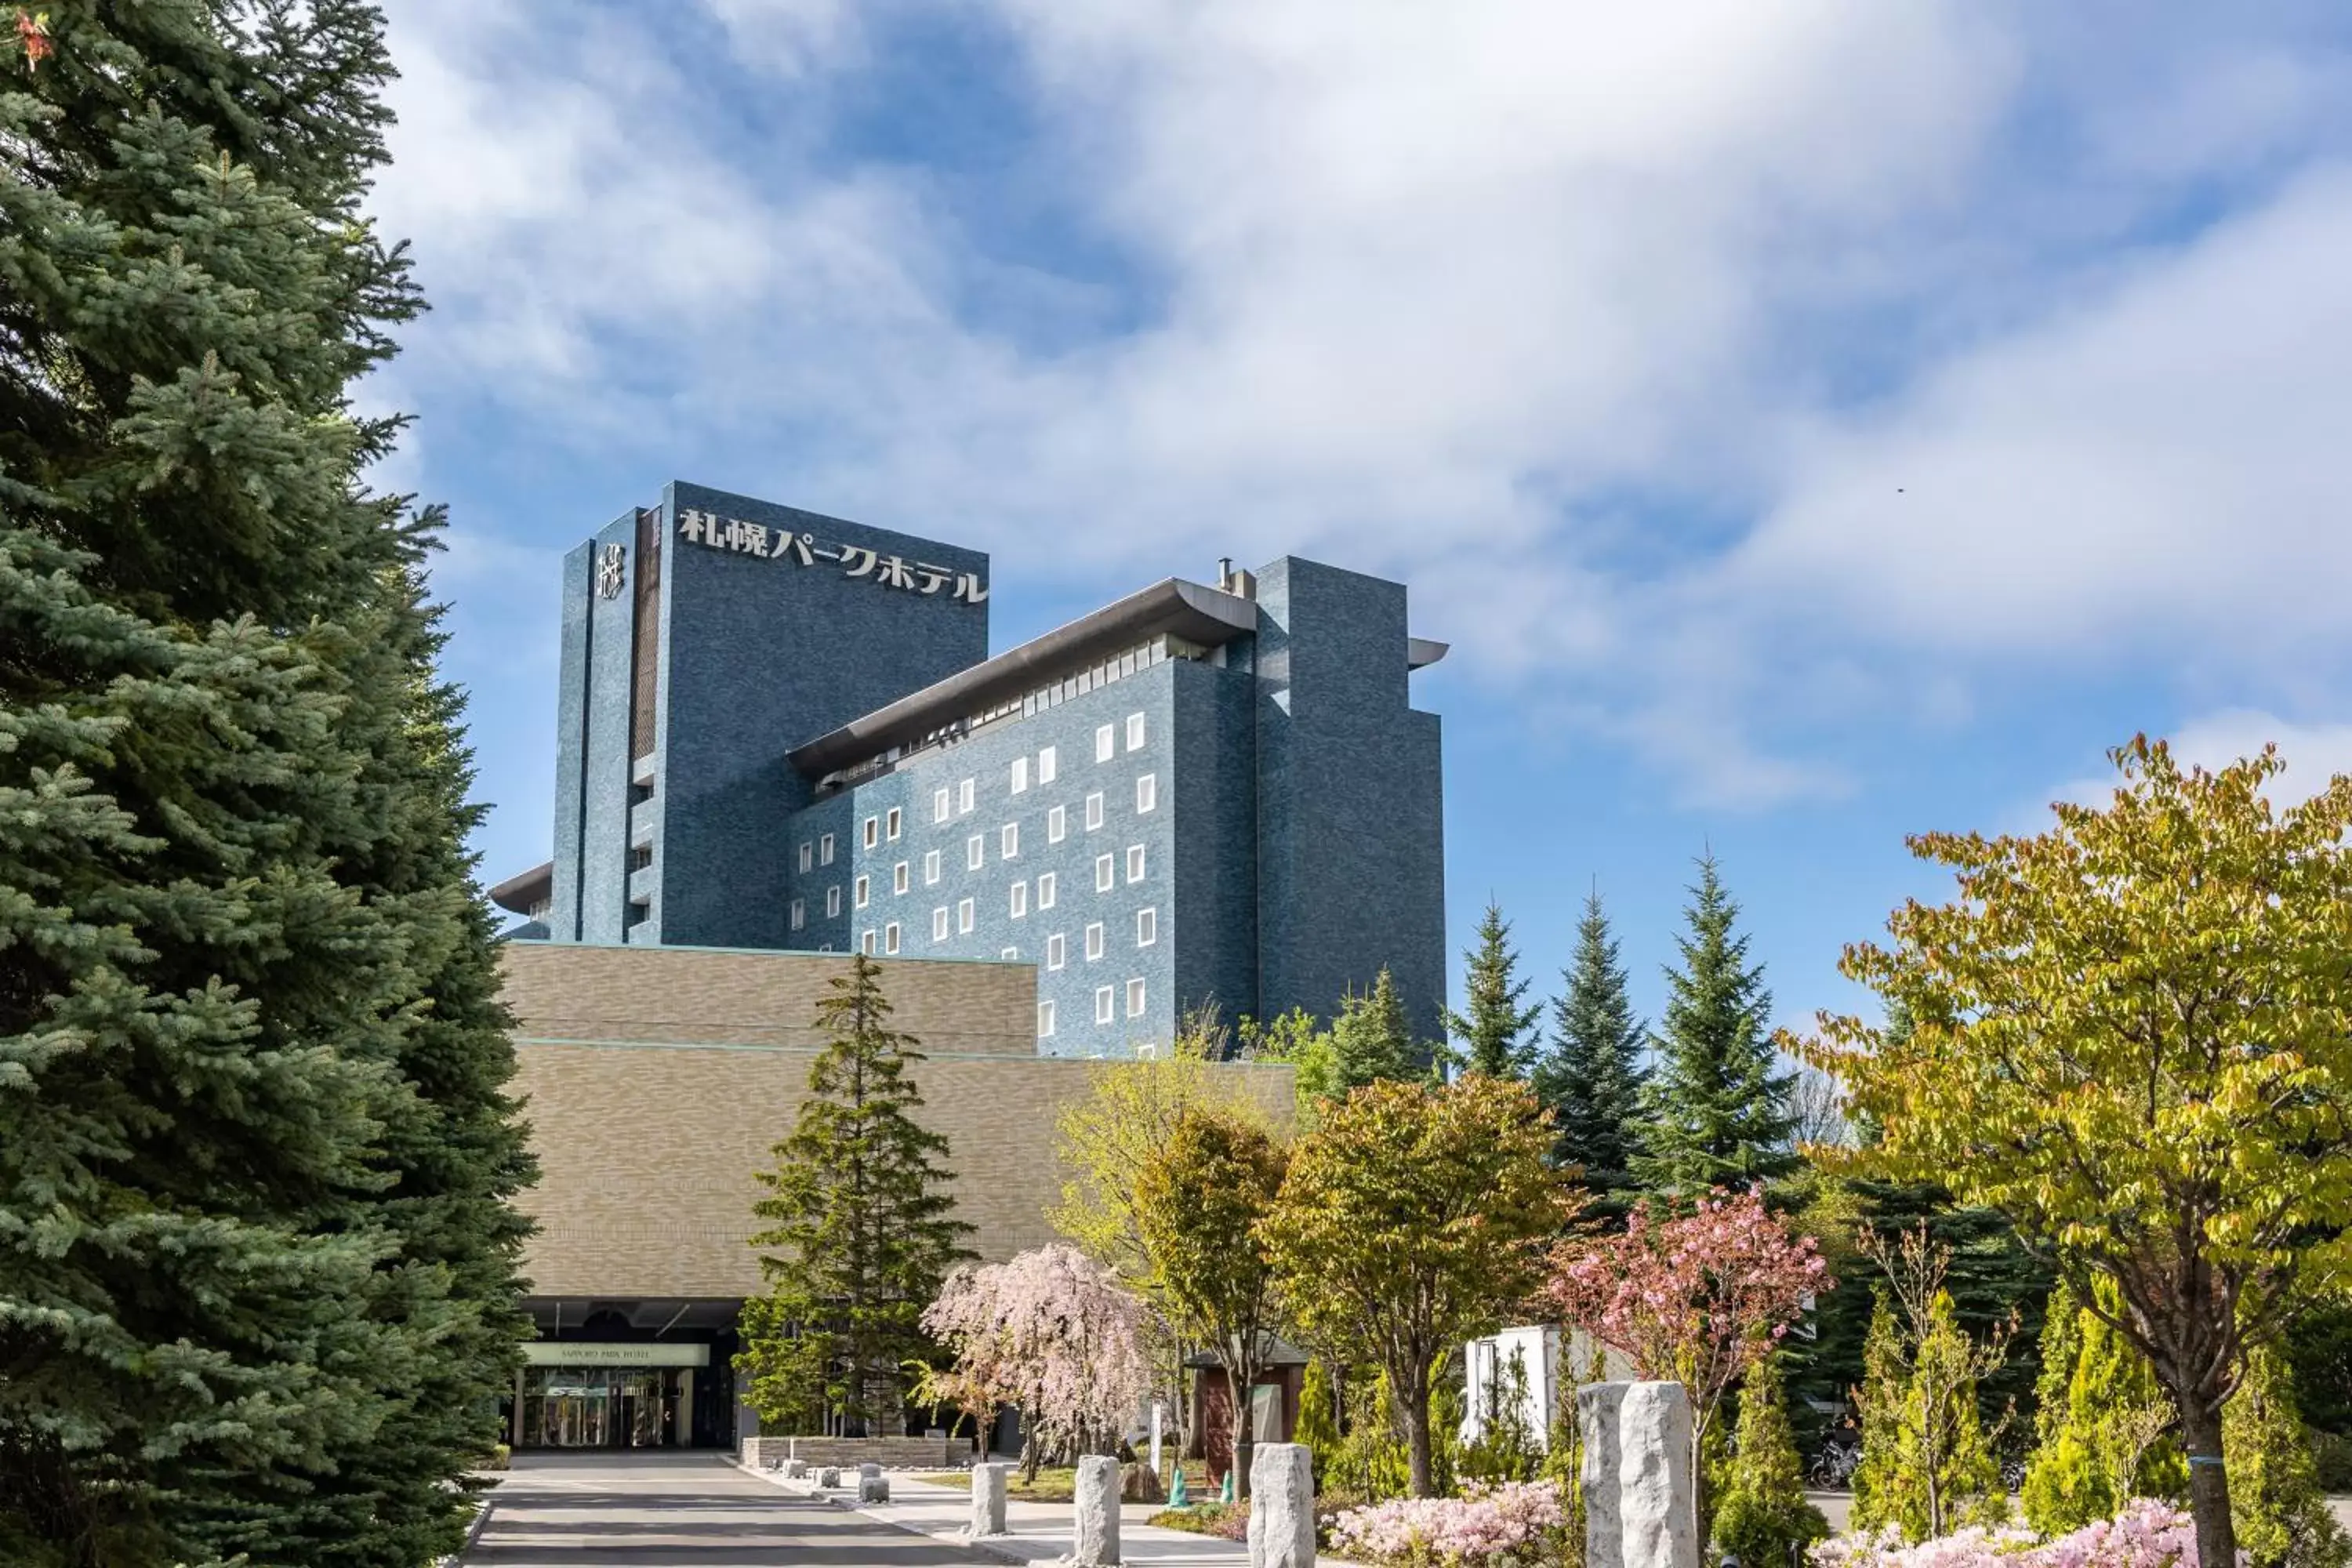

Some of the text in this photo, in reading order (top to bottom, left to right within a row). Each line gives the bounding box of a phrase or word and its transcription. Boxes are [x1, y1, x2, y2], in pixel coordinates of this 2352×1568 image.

[678, 508, 988, 603] 札幌パークホテル
